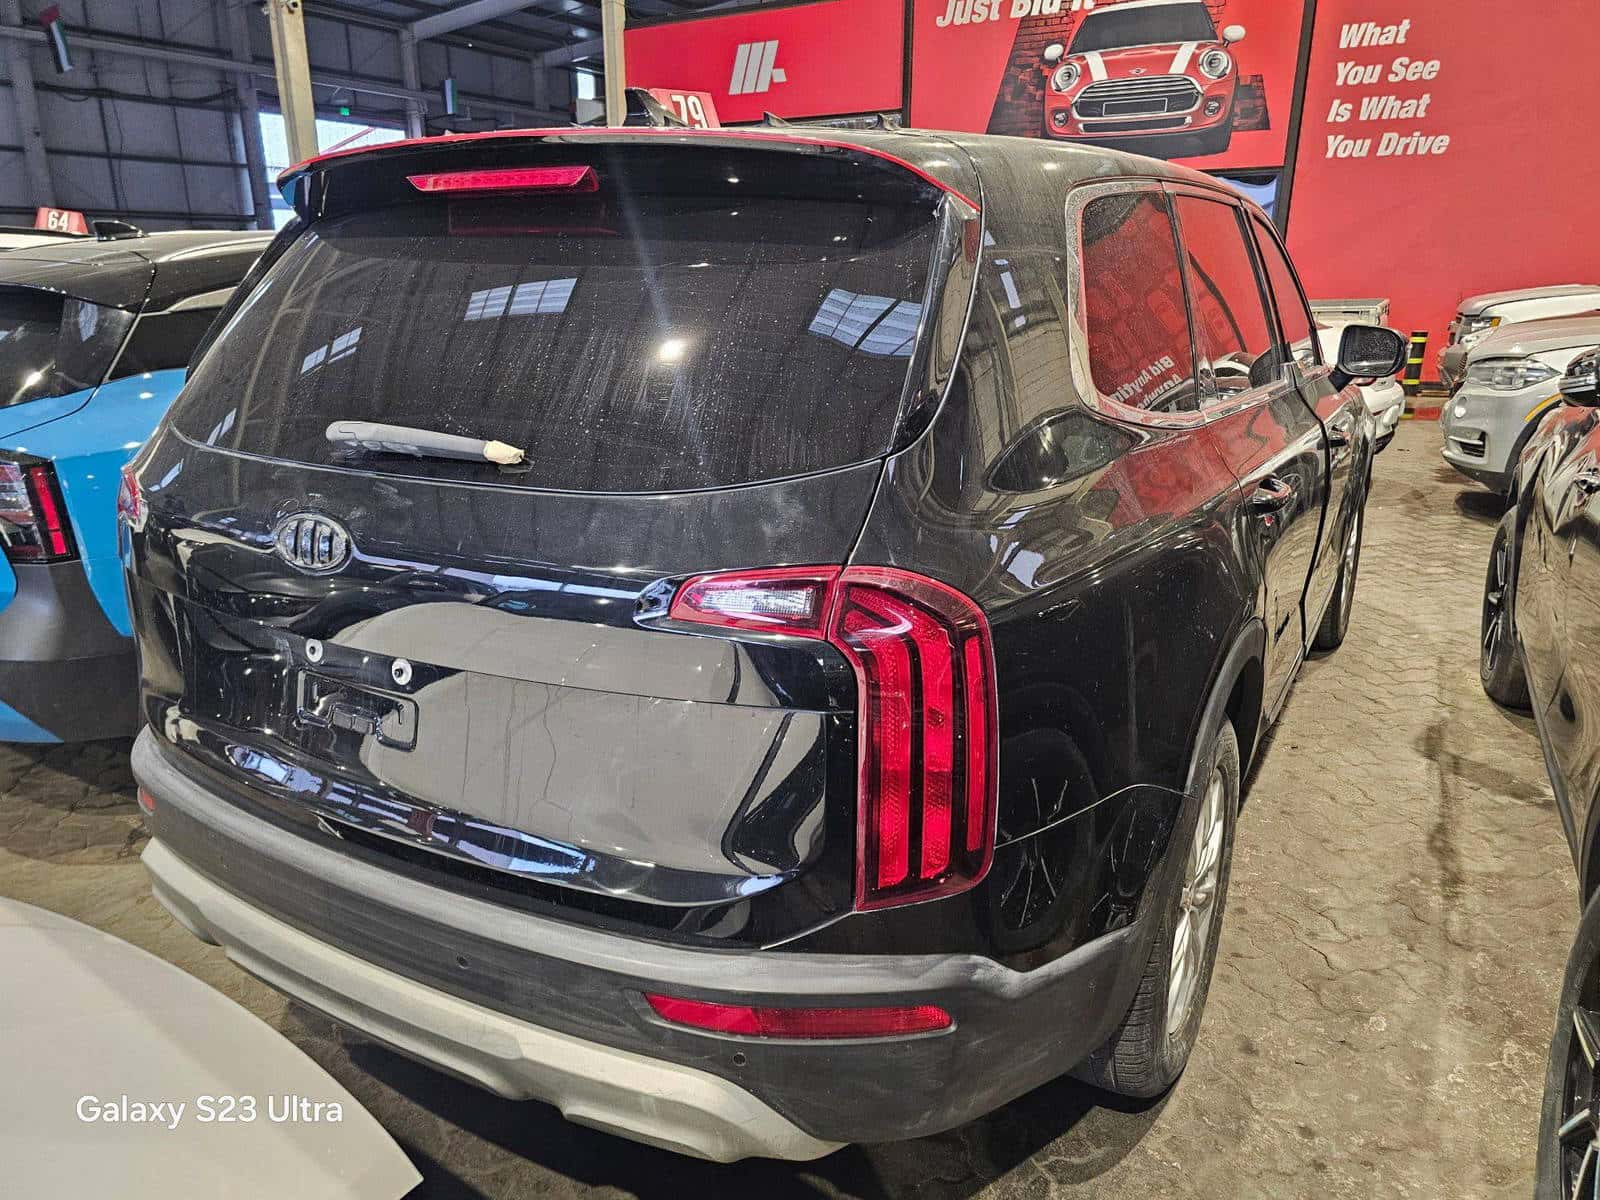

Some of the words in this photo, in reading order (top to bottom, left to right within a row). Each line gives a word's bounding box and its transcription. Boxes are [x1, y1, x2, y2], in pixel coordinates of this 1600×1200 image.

[936, 0, 1000, 27] Just
[1339, 18, 1411, 49] What
[1335, 61, 1383, 86] You
[1387, 56, 1441, 82] See
[671, 94, 708, 129] 79
[1326, 98, 1353, 123] Is
[1358, 93, 1431, 121] What
[1325, 134, 1372, 159] You
[1376, 131, 1450, 157] Drive
[47, 208, 69, 232] 64
